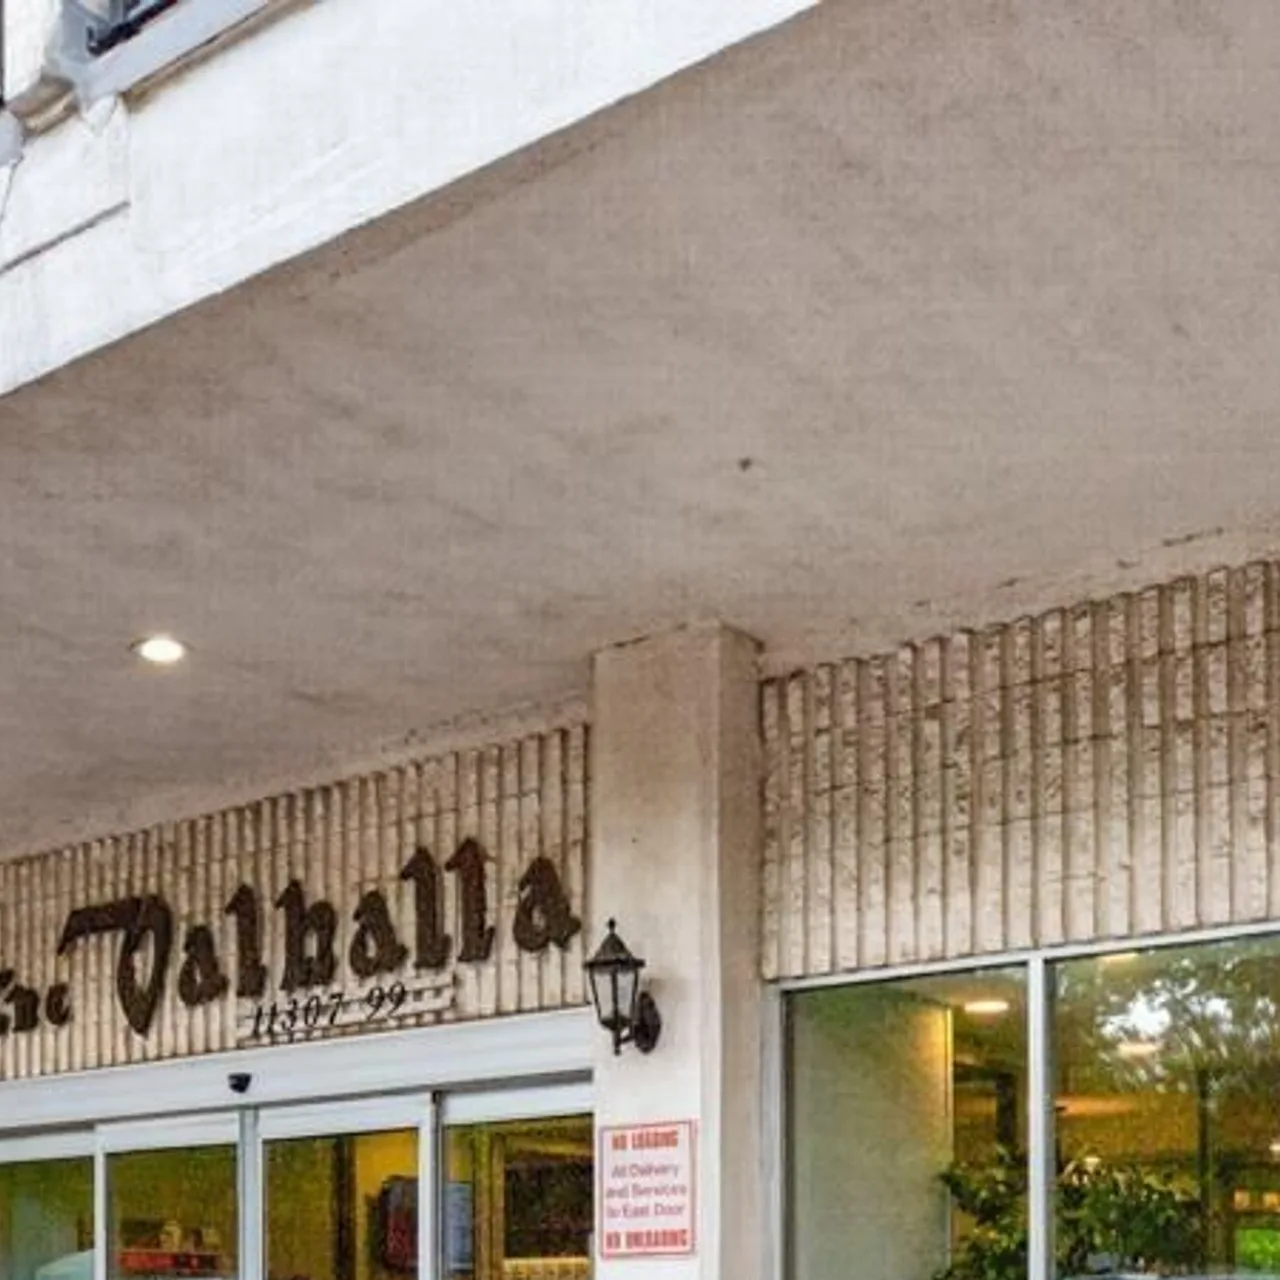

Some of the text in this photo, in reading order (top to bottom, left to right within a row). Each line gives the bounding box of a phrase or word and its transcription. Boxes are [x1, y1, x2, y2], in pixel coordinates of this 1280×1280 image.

[56, 836, 582, 1038] Valhalla
[252, 980, 407, 1040] 11307 99
[654, 1202, 685, 1216] Door
